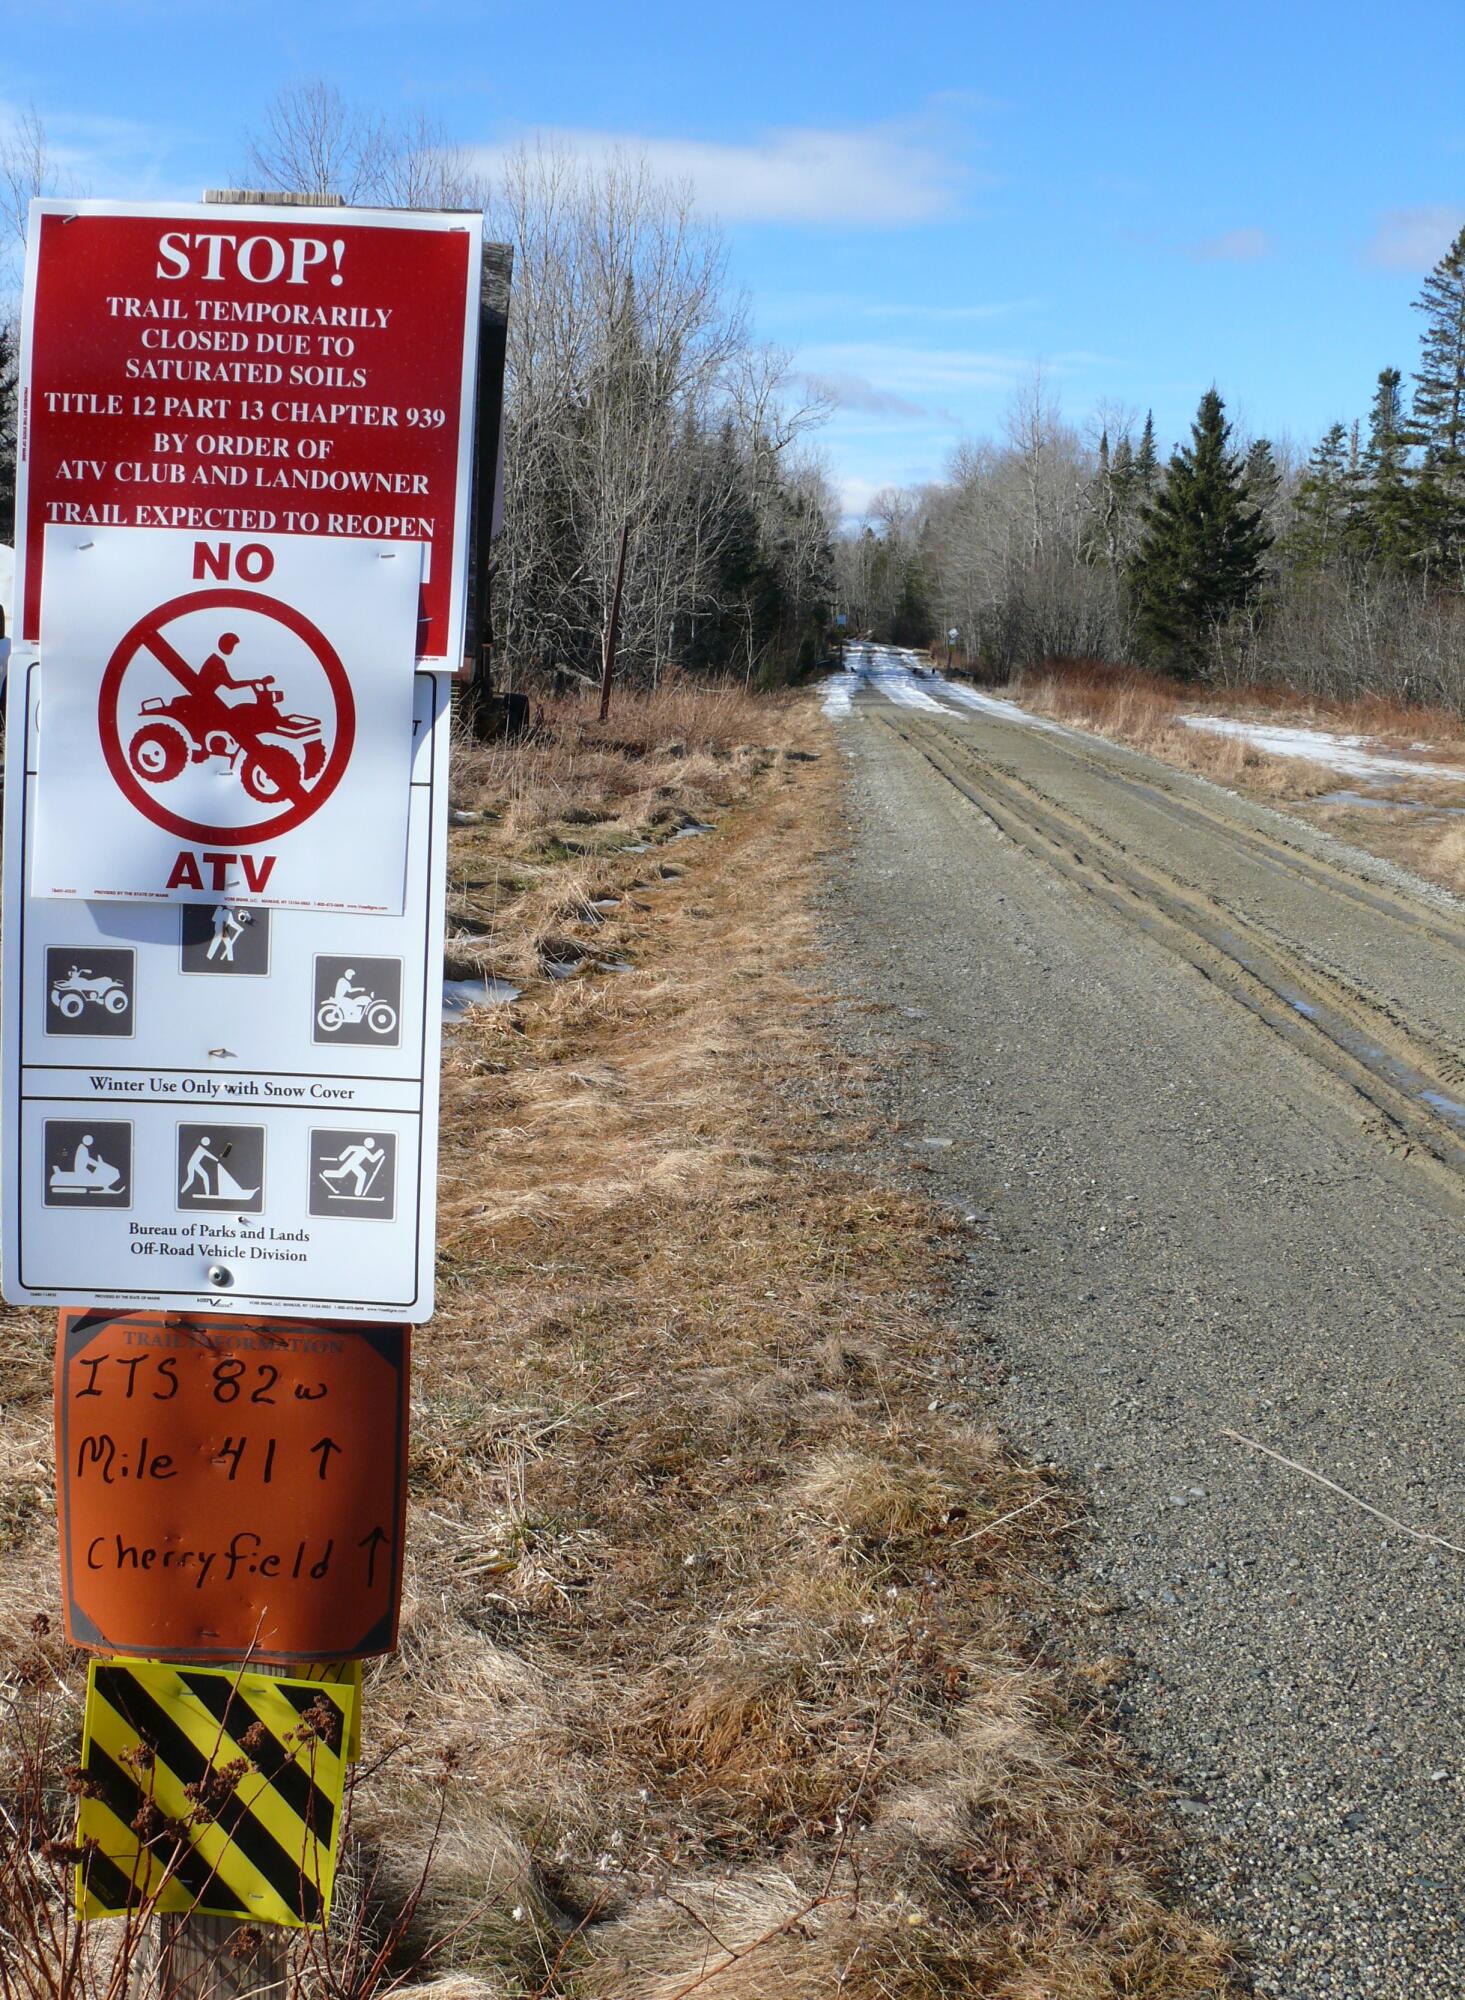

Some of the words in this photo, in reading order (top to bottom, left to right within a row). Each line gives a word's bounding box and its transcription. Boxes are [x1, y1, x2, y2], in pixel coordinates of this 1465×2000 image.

[156, 231, 347, 287] STOP!
[106, 296, 189, 321] TRAIL
[195, 300, 394, 329] TEMPORARILY
[141, 328, 249, 353] CLOSED
[256, 332, 310, 356] DUE
[317, 335, 356, 358] TO
[125, 358, 284, 386] SATURATED
[289, 364, 368, 389] SOILS
[44, 392, 124, 416] TITLE
[132, 395, 157, 418] 12
[163, 396, 231, 421] PART
[239, 399, 265, 421] 13
[270, 400, 399, 428] CHAPTER
[406, 407, 447, 430] 939
[153, 432, 189, 454] BY
[195, 433, 290, 460] ORDER
[296, 437, 335, 461] OF
[55, 460, 108, 482] ATV
[114, 461, 187, 485] CLUB
[191, 464, 249, 488] AND
[254, 466, 430, 496] LANDOWNER
[46, 502, 128, 526] TRAIL
[135, 505, 277, 532] EXPECTED
[282, 511, 320, 533] TO
[327, 513, 436, 539] REOPEN
[191, 541, 276, 584] NO
[165, 851, 278, 894] ATV
[89, 1076, 145, 1092] Winter
[150, 1079, 177, 1093] Use
[181, 1079, 220, 1098] Only
[223, 1081, 259, 1096] with
[263, 1082, 306, 1097] Snow
[310, 1084, 355, 1100] Cover
[129, 1222, 177, 1237] Bureau
[181, 1223, 198, 1237] of
[199, 1225, 236, 1239] Parks
[239, 1226, 266, 1240] and
[269, 1228, 311, 1243] Lands
[130, 1242, 195, 1257] Off-Road
[197, 1244, 247, 1259] Vehicle
[250, 1247, 308, 1262] Division
[124, 1330, 183, 1348] TRAIL
[76, 1354, 180, 1400] ITS
[212, 1359, 279, 1405] 82
[77, 1434, 179, 1484] Mile
[218, 1436, 276, 1483] 41
[87, 1532, 334, 1589] Cherryfield
